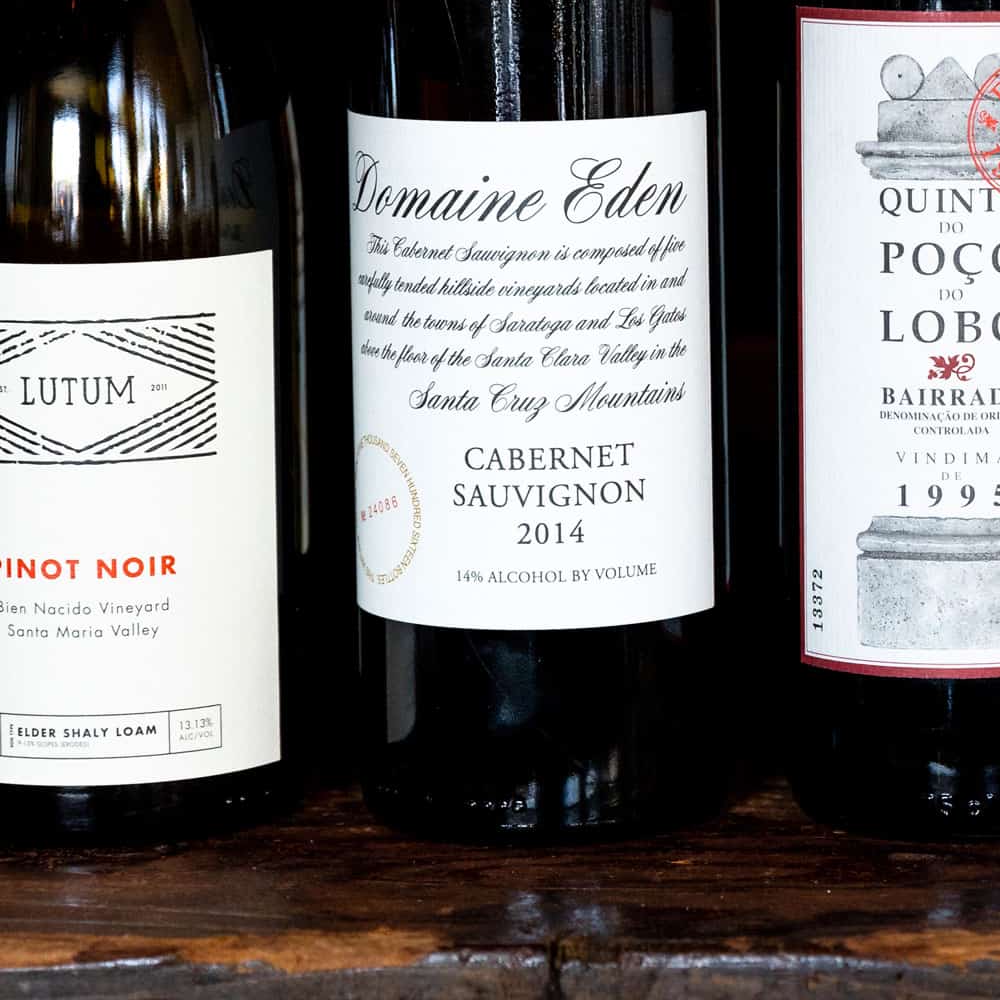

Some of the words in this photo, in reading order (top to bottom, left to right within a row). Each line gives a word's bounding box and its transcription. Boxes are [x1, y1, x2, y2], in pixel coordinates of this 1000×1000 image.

[352, 150, 548, 224] Domaine
[562, 157, 688, 225] Eden
[938, 221, 964, 234] DO
[367, 232, 389, 257] This
[392, 236, 454, 261] Cabernet
[454, 240, 551, 270] Sauvignon
[553, 243, 570, 262] is
[572, 236, 650, 266] composed
[648, 234, 666, 263] of
[659, 233, 686, 262] five
[393, 275, 437, 296] tended
[436, 276, 496, 297] hillside
[497, 276, 583, 305] vineyards
[583, 272, 643, 296] located
[640, 274, 658, 293] in
[658, 266, 689, 290] and
[938, 288, 964, 301] DO
[401, 310, 422, 329] the
[422, 313, 467, 332] towns
[467, 313, 491, 340] of
[488, 311, 573, 340] Saratoga
[574, 309, 615, 331] and
[614, 306, 646, 330] Los
[648, 303, 688, 335] Gatos
[380, 342, 397, 360] the
[394, 343, 428, 369] floor
[429, 347, 450, 373] of
[447, 347, 473, 367] the
[474, 346, 534, 369] Santa
[539, 345, 591, 368] Clara
[598, 342, 649, 370] Valley
[648, 343, 668, 361] in
[667, 338, 688, 359] the
[20, 375, 136, 406] LUTUM
[150, 383, 168, 392] 2011
[408, 380, 481, 414] Santa
[488, 382, 550, 424] Cruz
[554, 380, 687, 414] Mountains
[879, 409, 960, 424] DENOMINAÇÃO
[962, 411, 978, 422] DE
[912, 425, 991, 436] CONTROLADA
[463, 442, 636, 472] CABERNET
[940, 470, 963, 481] DE
[452, 478, 647, 509] SAUVIGNON
[516, 519, 586, 546] 2014
[0, 557, 80, 580] INOT
[96, 554, 177, 580] NOIR
[456, 569, 484, 583] 14%
[487, 569, 568, 584] ALCOHOL
[572, 568, 592, 583] BY
[595, 562, 658, 581] VOLUME
[34, 601, 92, 616] Nacido
[99, 597, 170, 617] Vineyard
[811, 567, 824, 632] 13372
[7, 623, 49, 638] Santa
[56, 625, 104, 639] Maria
[111, 622, 160, 639] Valley
[17, 727, 56, 738] ELDER
[63, 728, 109, 738] SHALY
[116, 724, 157, 737] LOAM
